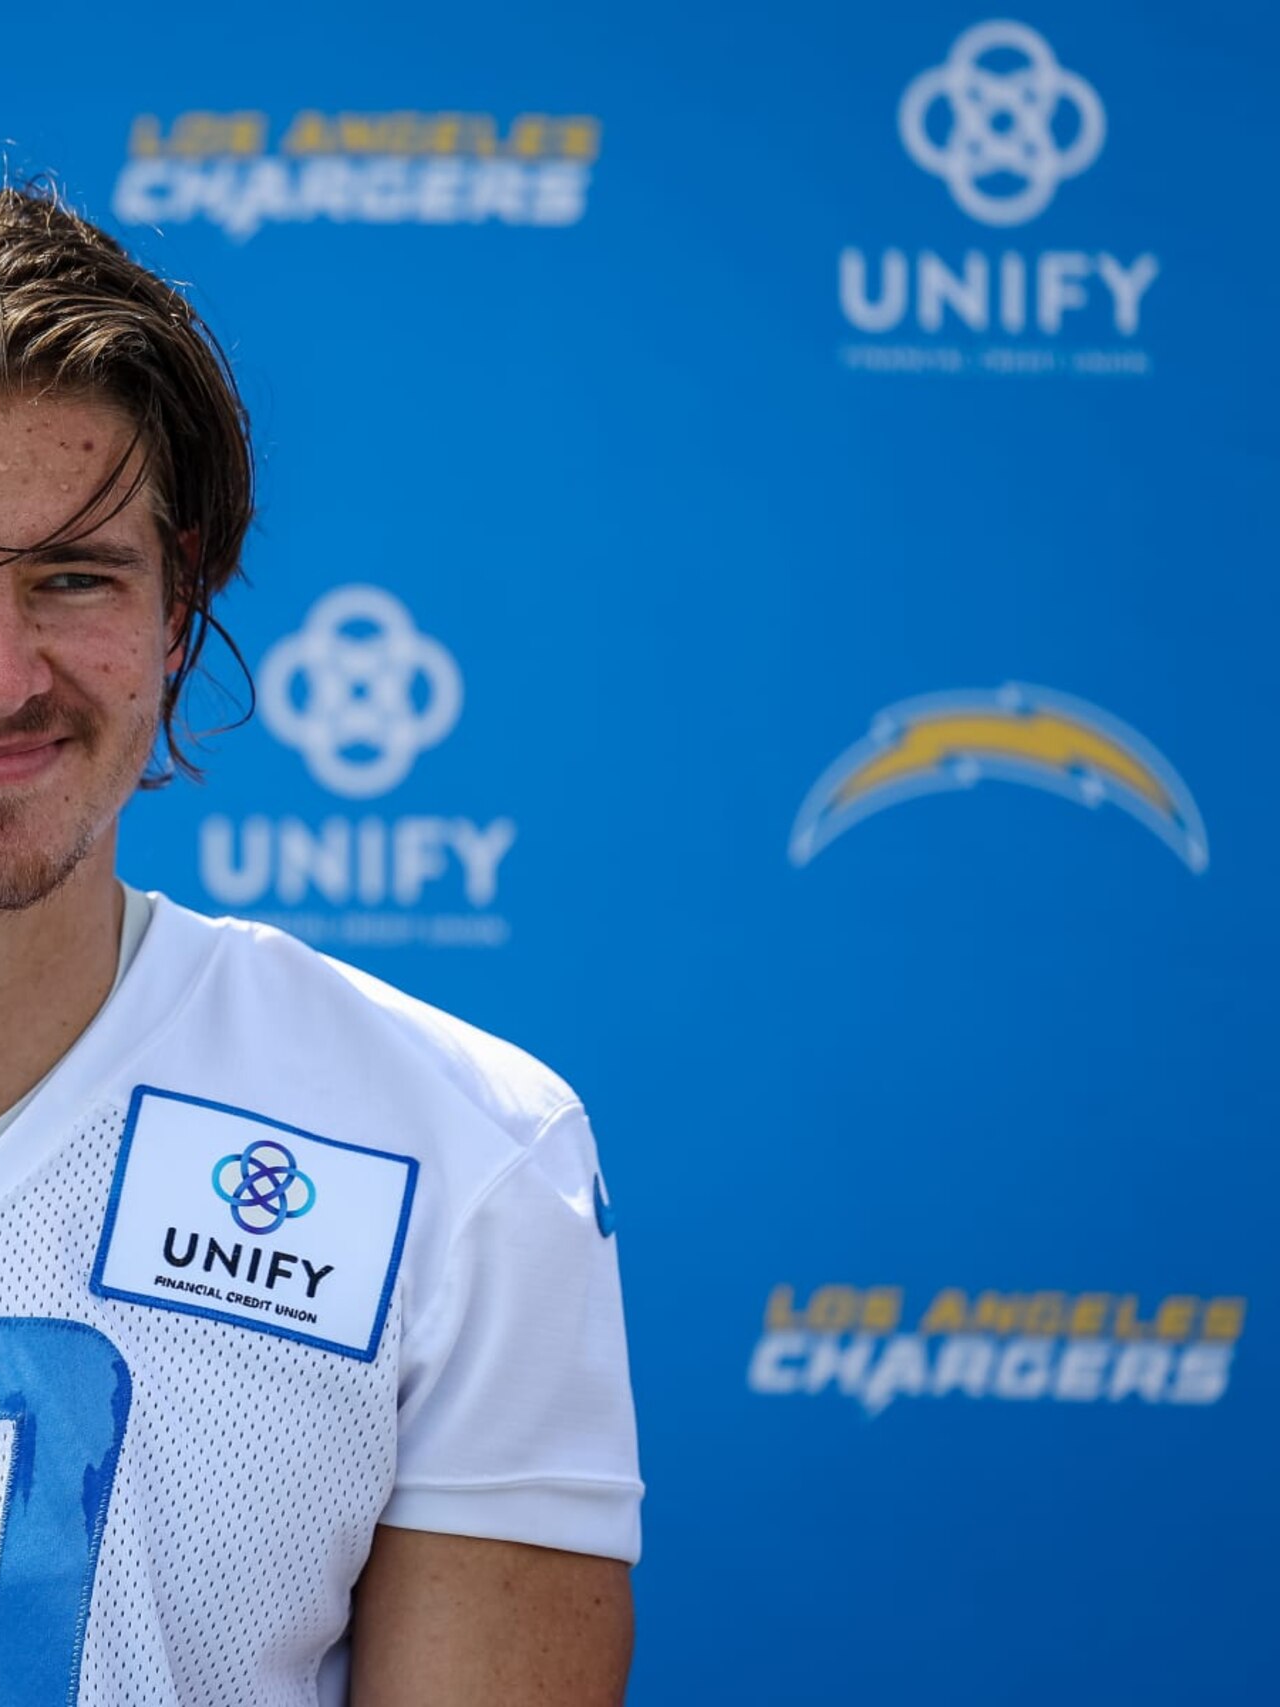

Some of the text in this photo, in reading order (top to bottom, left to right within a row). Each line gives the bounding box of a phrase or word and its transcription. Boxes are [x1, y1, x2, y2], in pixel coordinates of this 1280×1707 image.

[128, 110, 601, 162] LOS ANGELES
[112, 155, 591, 243] CHARGERS
[838, 246, 1160, 336] UNIFY
[198, 813, 517, 908] UNIFY
[154, 1275, 318, 1324] FINANCIAL CREDIT UNION
[163, 1227, 335, 1298] UNIFY
[764, 1284, 1247, 1343] LOS ANGELES
[747, 1331, 1233, 1420] CHARGERS
